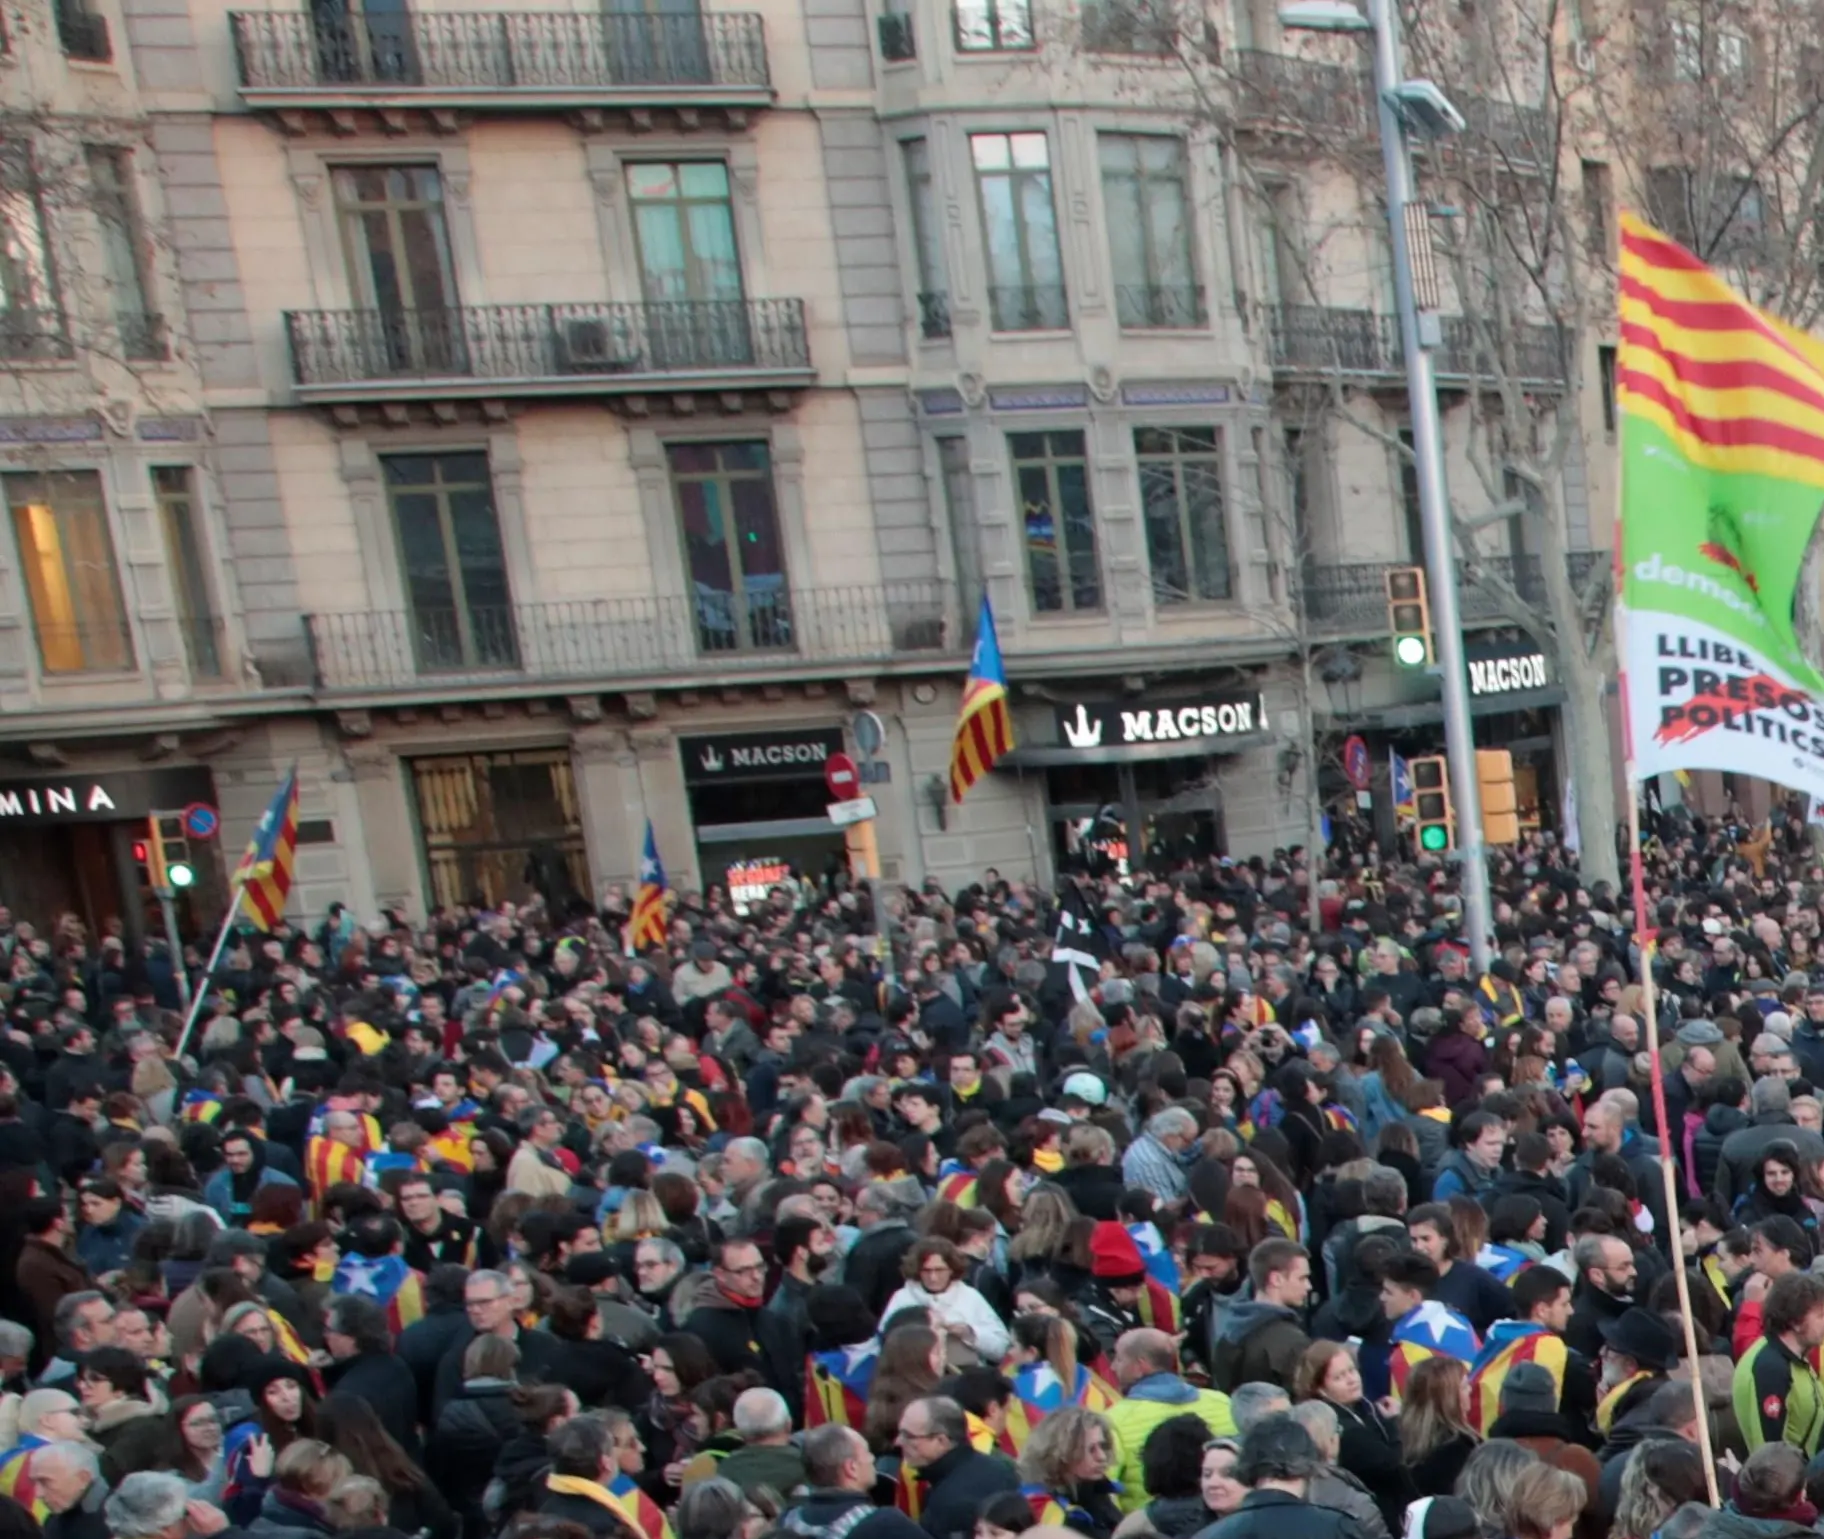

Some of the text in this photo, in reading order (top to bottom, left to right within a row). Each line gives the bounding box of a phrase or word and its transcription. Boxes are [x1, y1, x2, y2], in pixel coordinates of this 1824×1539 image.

[1468, 653, 1547, 695] MACSON
[1120, 701, 1254, 742] MACSON
[731, 742, 828, 767] MACSON
